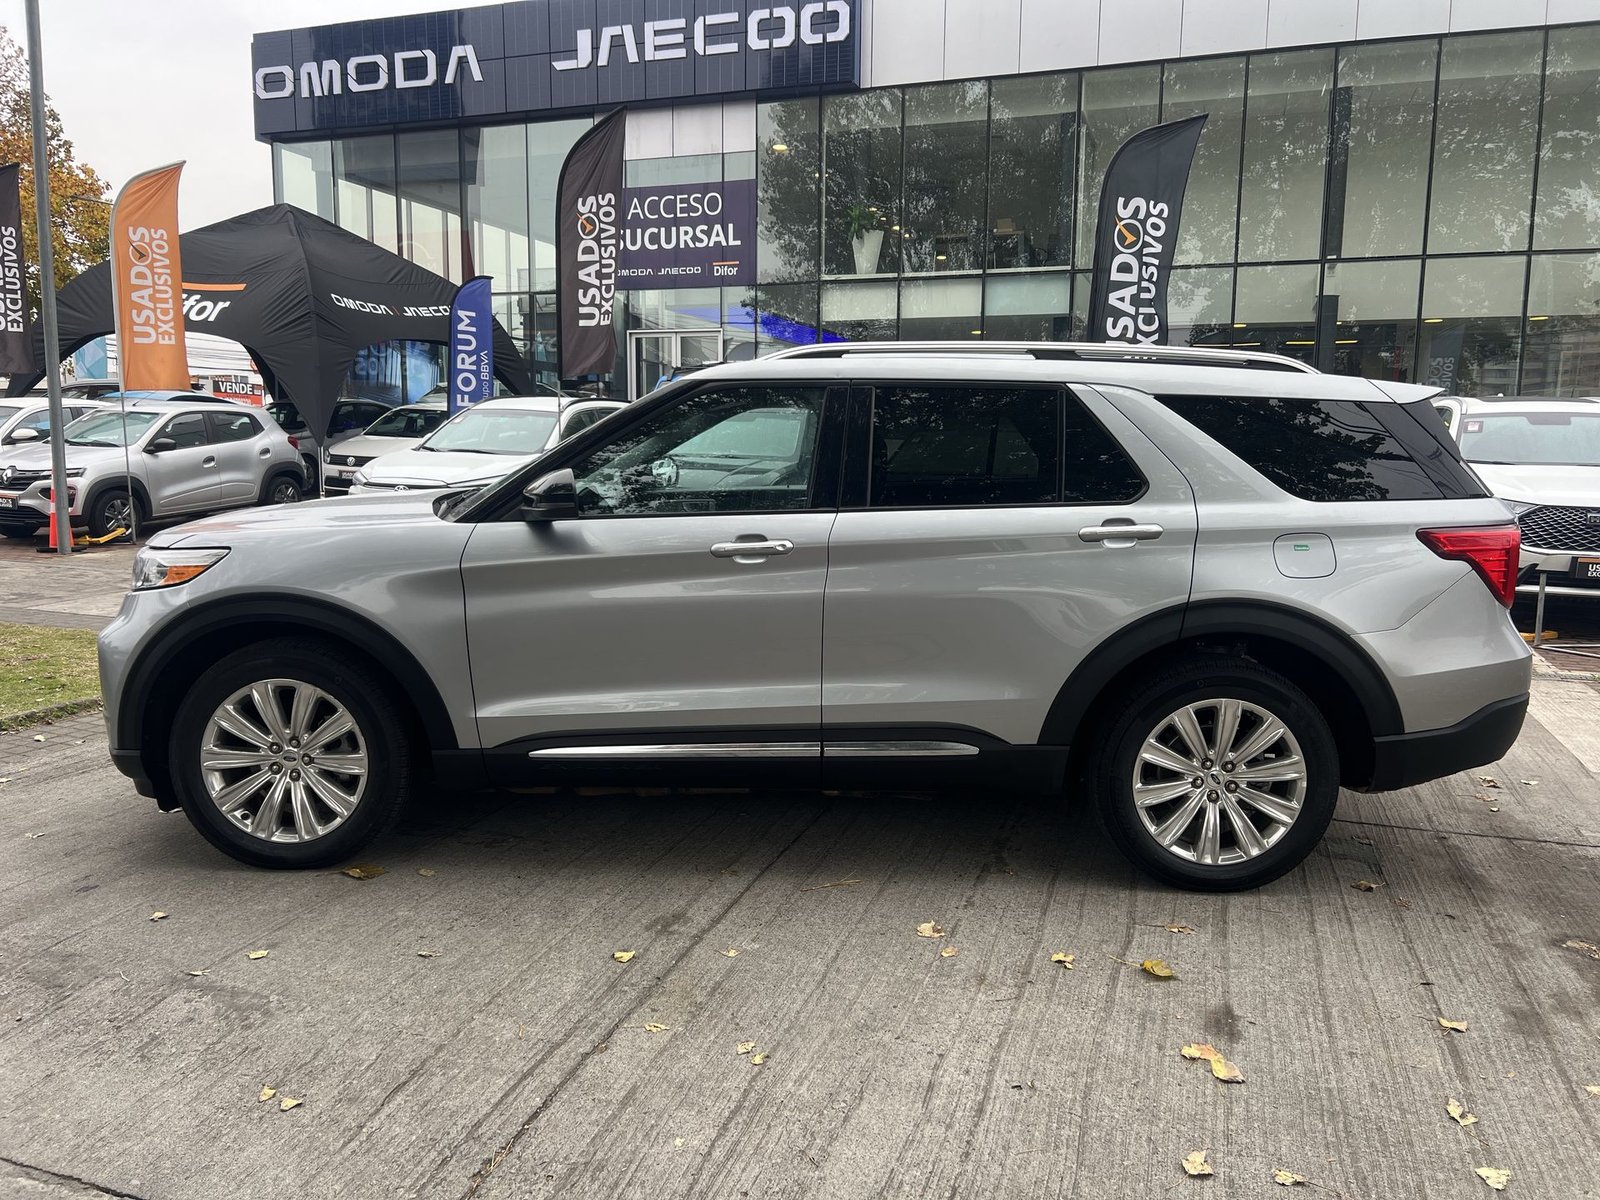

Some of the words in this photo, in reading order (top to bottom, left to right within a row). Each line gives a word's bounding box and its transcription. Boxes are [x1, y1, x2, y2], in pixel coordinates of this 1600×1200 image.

[255, 44, 484, 100] OMODA
[551, 0, 850, 71] JAECOO
[627, 192, 722, 220] ACCESO
[1, 226, 24, 333] EXCLUSIVOS
[128, 226, 157, 344] USADOS
[151, 228, 176, 345] EXCLUSIVOS
[330, 293, 394, 315] OMODA
[577, 195, 600, 327] USADOS
[598, 192, 616, 326] EXCLUSIVOS
[657, 266, 702, 276] JAECOO
[713, 265, 738, 276] Difor
[1136, 200, 1169, 346] XCLUSIVOS
[219, 381, 253, 395] VENDE
[456, 309, 477, 407] FORUM
[480, 350, 489, 380] BBVA
